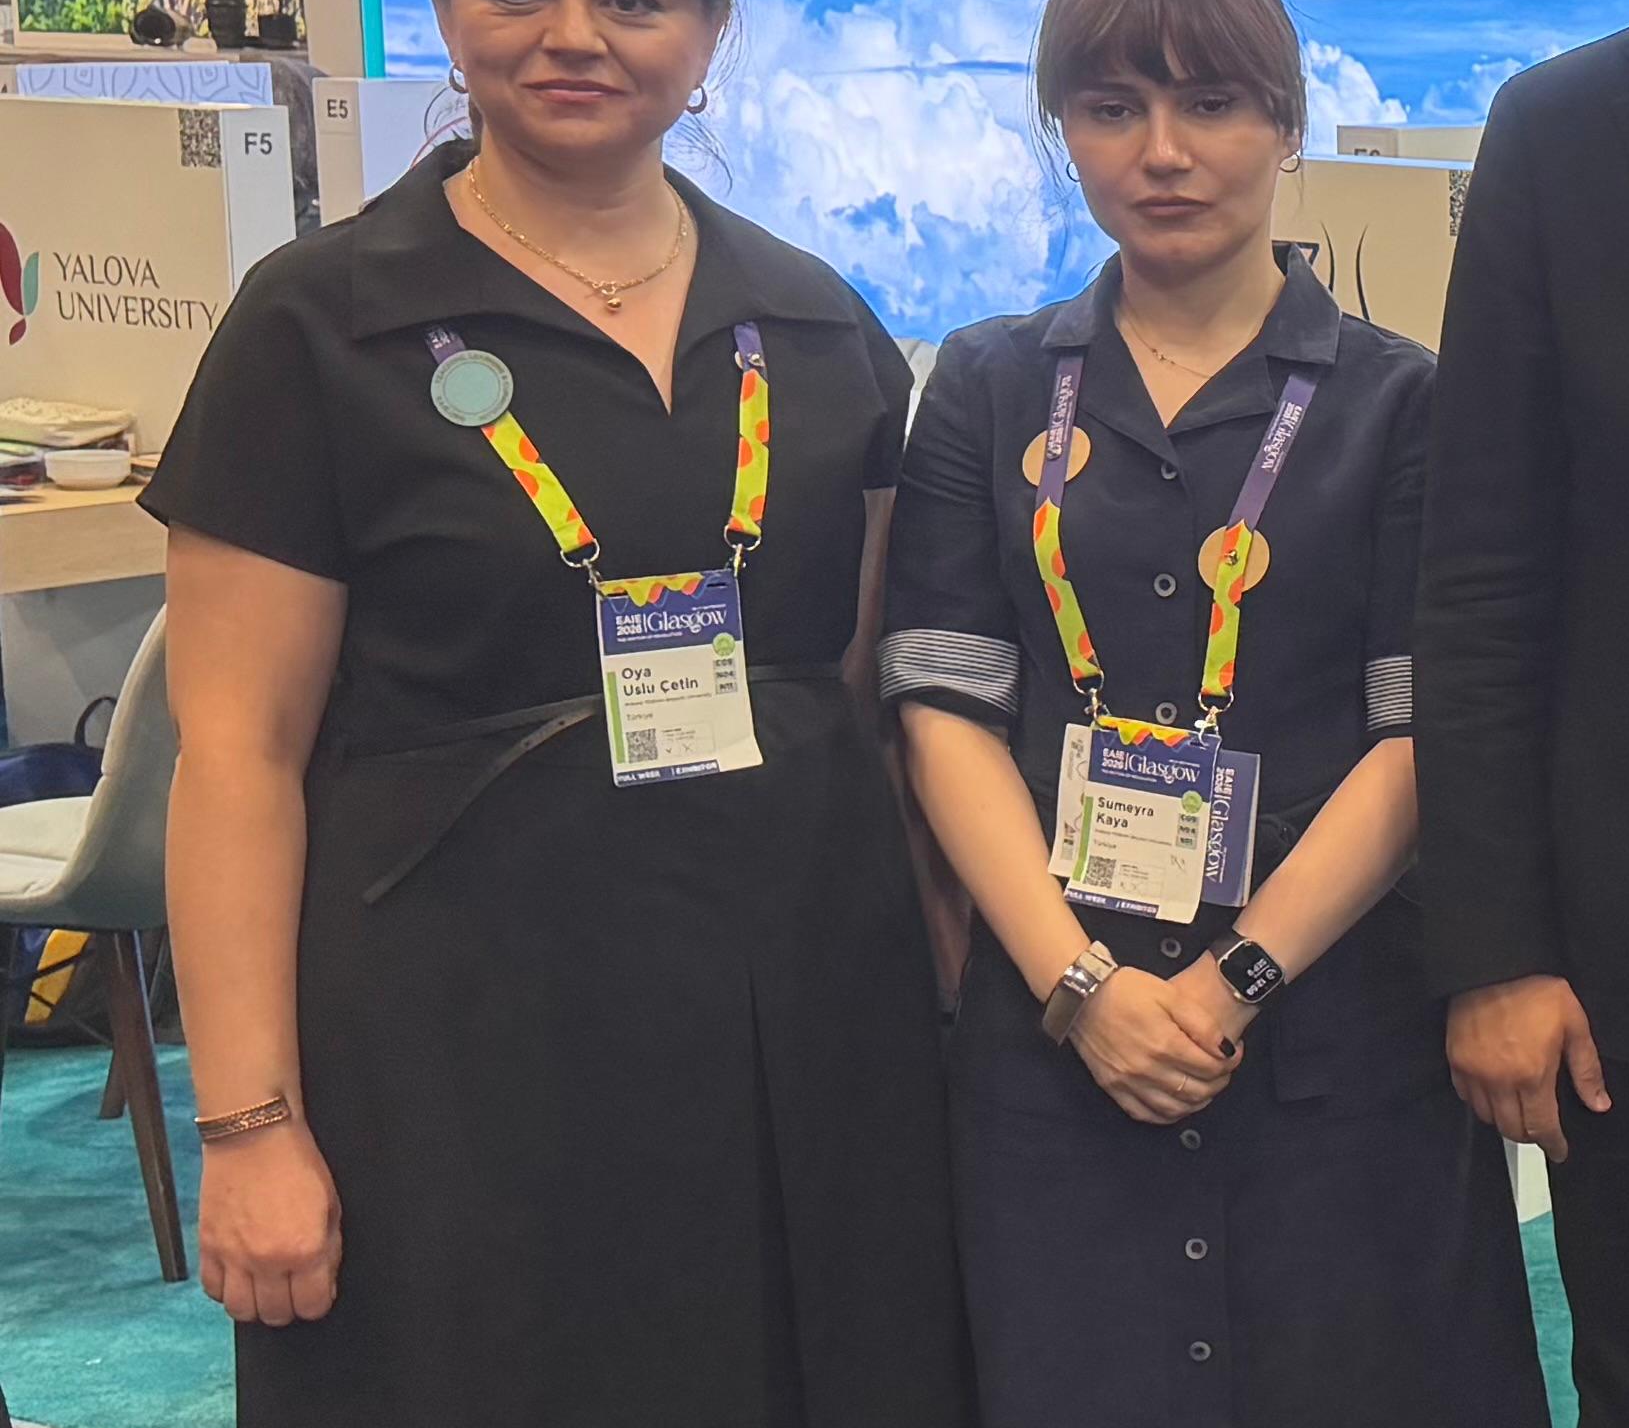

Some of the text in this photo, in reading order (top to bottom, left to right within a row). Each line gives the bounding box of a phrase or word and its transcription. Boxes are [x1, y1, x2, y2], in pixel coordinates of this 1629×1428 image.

[327, 99, 348, 118] E5
[244, 133, 272, 155] F5
[54, 253, 159, 289] YALOVA
[57, 292, 218, 330] UNIVERSITY
[648, 610, 726, 633] Glasgow
[622, 668, 651, 680] Oya
[624, 678, 698, 696] Uslu Çetin
[1129, 754, 1200, 784] Glasgow
[1098, 797, 1154, 817] Sumeyra
[1096, 812, 1129, 828] Kaya
[1206, 800, 1231, 883] Glasgow
